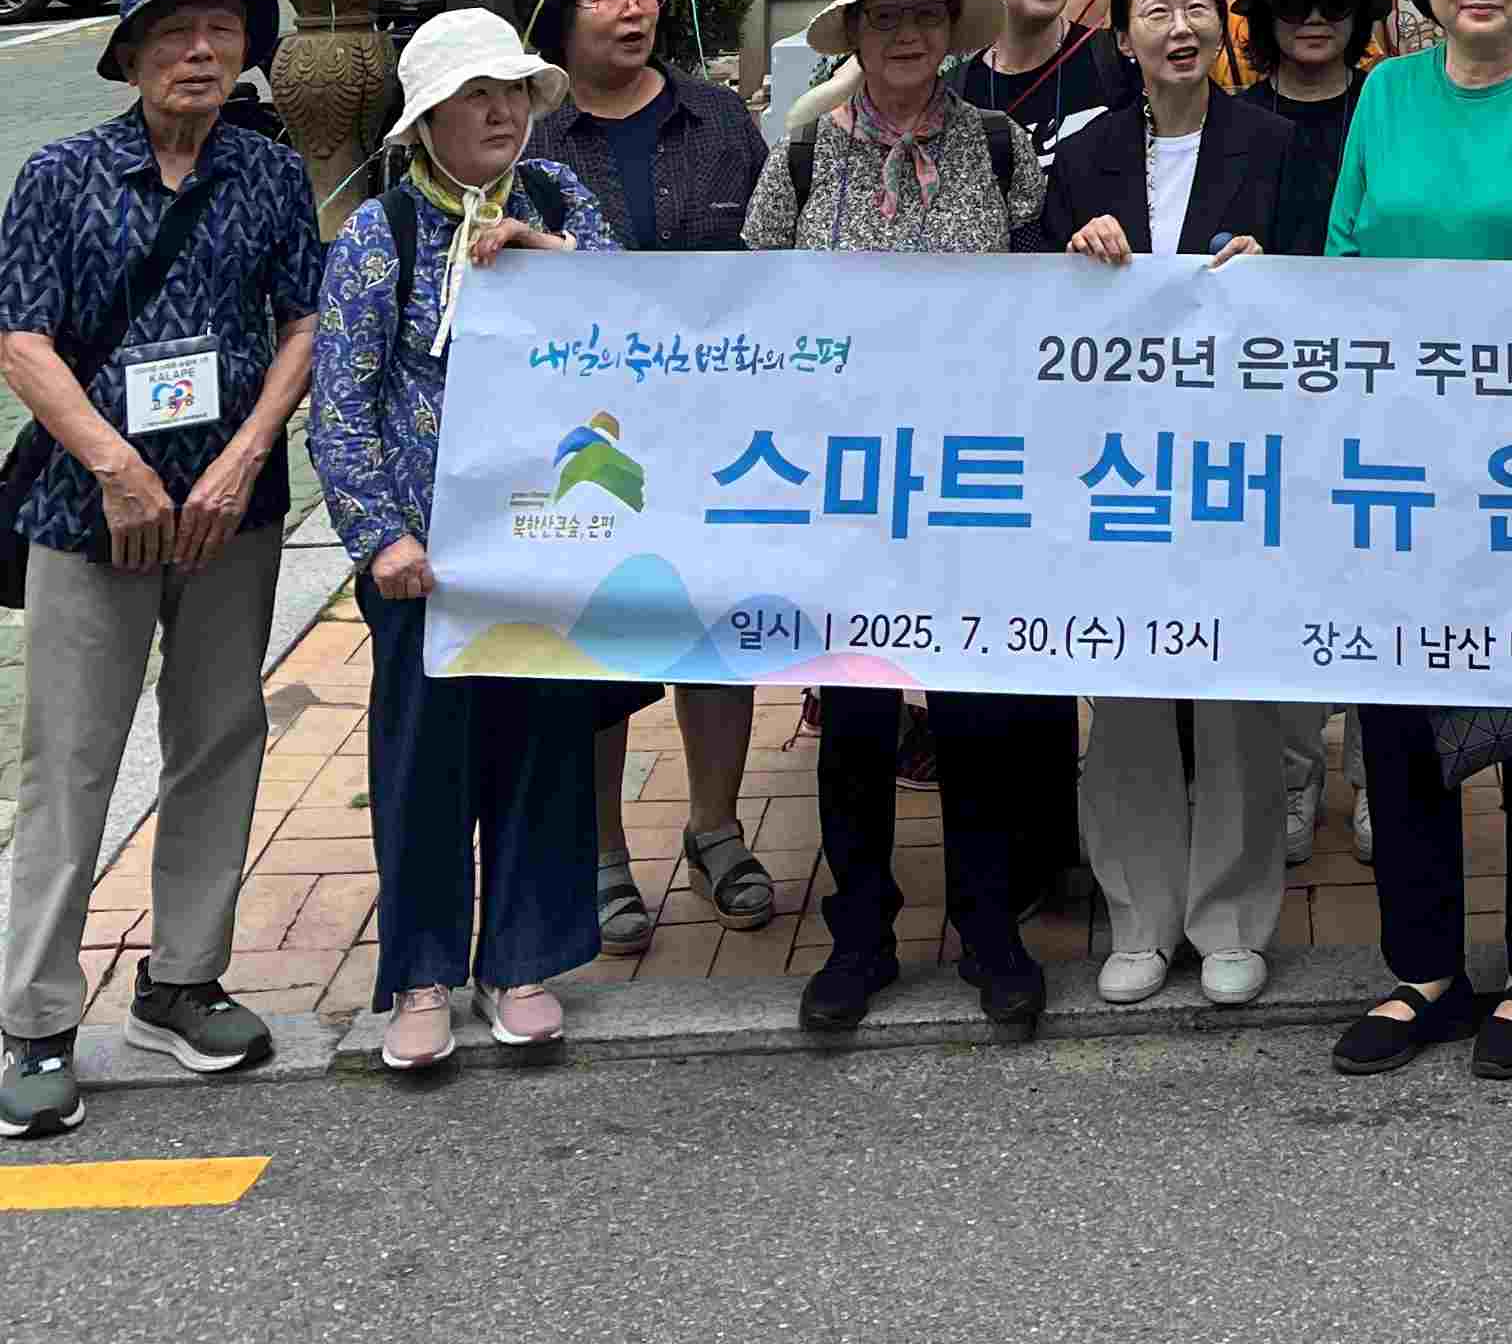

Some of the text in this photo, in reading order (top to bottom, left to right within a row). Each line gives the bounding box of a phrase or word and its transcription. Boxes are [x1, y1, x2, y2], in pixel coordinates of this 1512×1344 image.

[789, 335, 852, 375] 은평
[1036, 334, 1217, 389] 2025년
[1237, 337, 1396, 394] 은평구
[704, 427, 1032, 540] 스마트
[1079, 430, 1284, 548] 실버
[1331, 437, 1437, 553] 뉴
[730, 610, 801, 652] 일시
[849, 614, 941, 655] 2025.
[960, 617, 990, 656] 7.
[1006, 614, 1127, 660] 30.(수)
[1145, 617, 1222, 662] 13시
[1302, 622, 1378, 666] 장소
[1420, 624, 1497, 671] 남산
